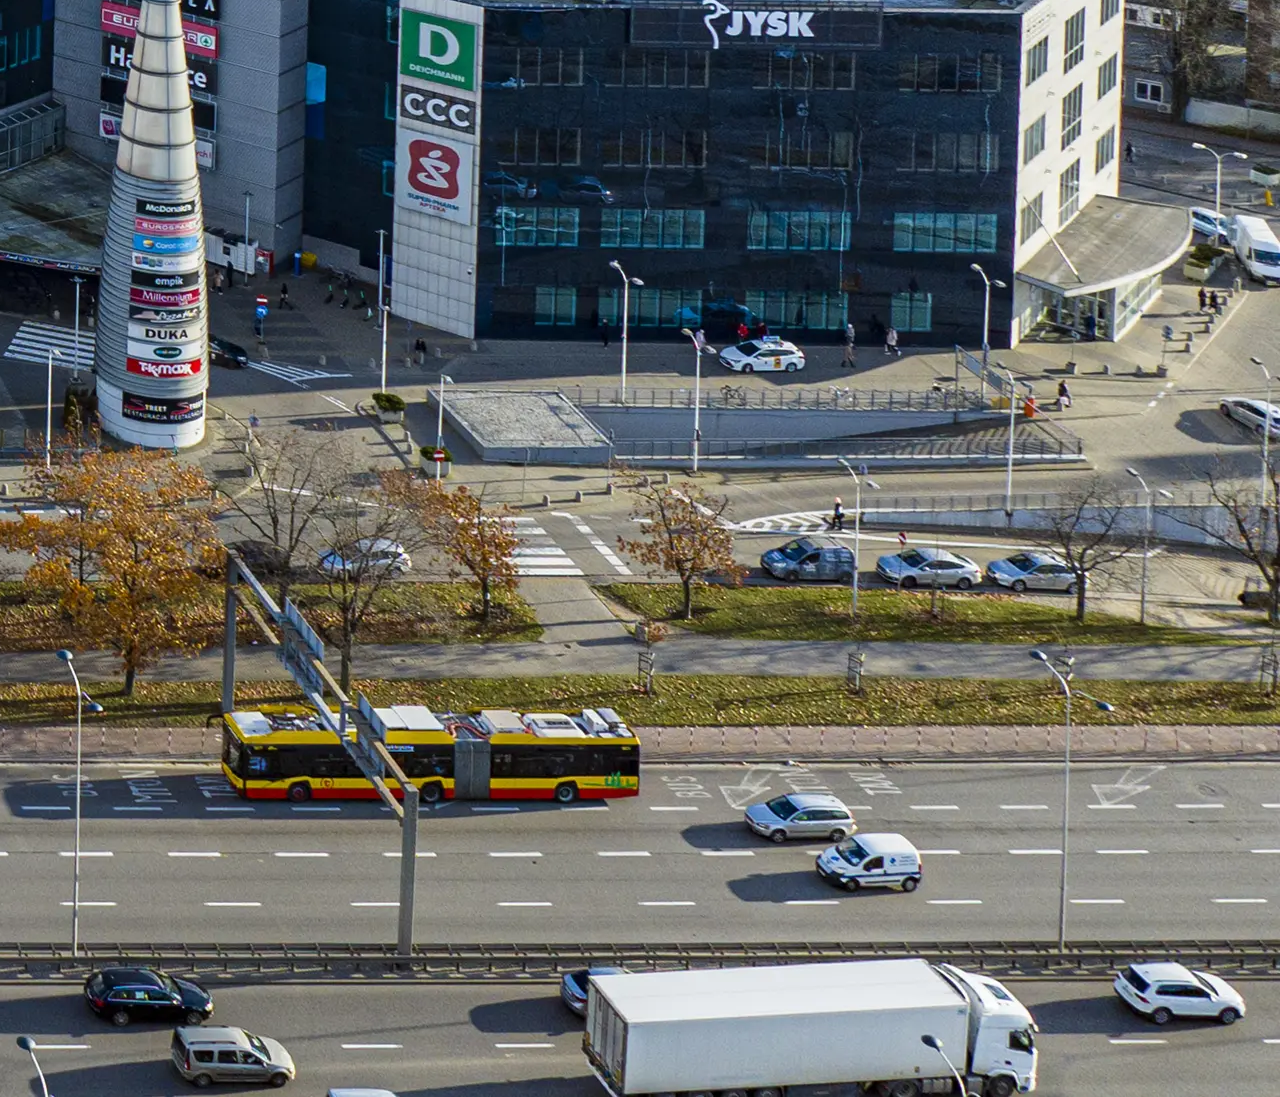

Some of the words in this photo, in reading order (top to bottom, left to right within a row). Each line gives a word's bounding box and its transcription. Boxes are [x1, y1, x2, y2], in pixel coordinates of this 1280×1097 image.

[724, 10, 815, 38] JYSK
[408, 63, 466, 83] DEICHMANN
[403, 92, 471, 128] CCC
[155, 276, 184, 286] empik
[144, 328, 189, 340] DUKA
